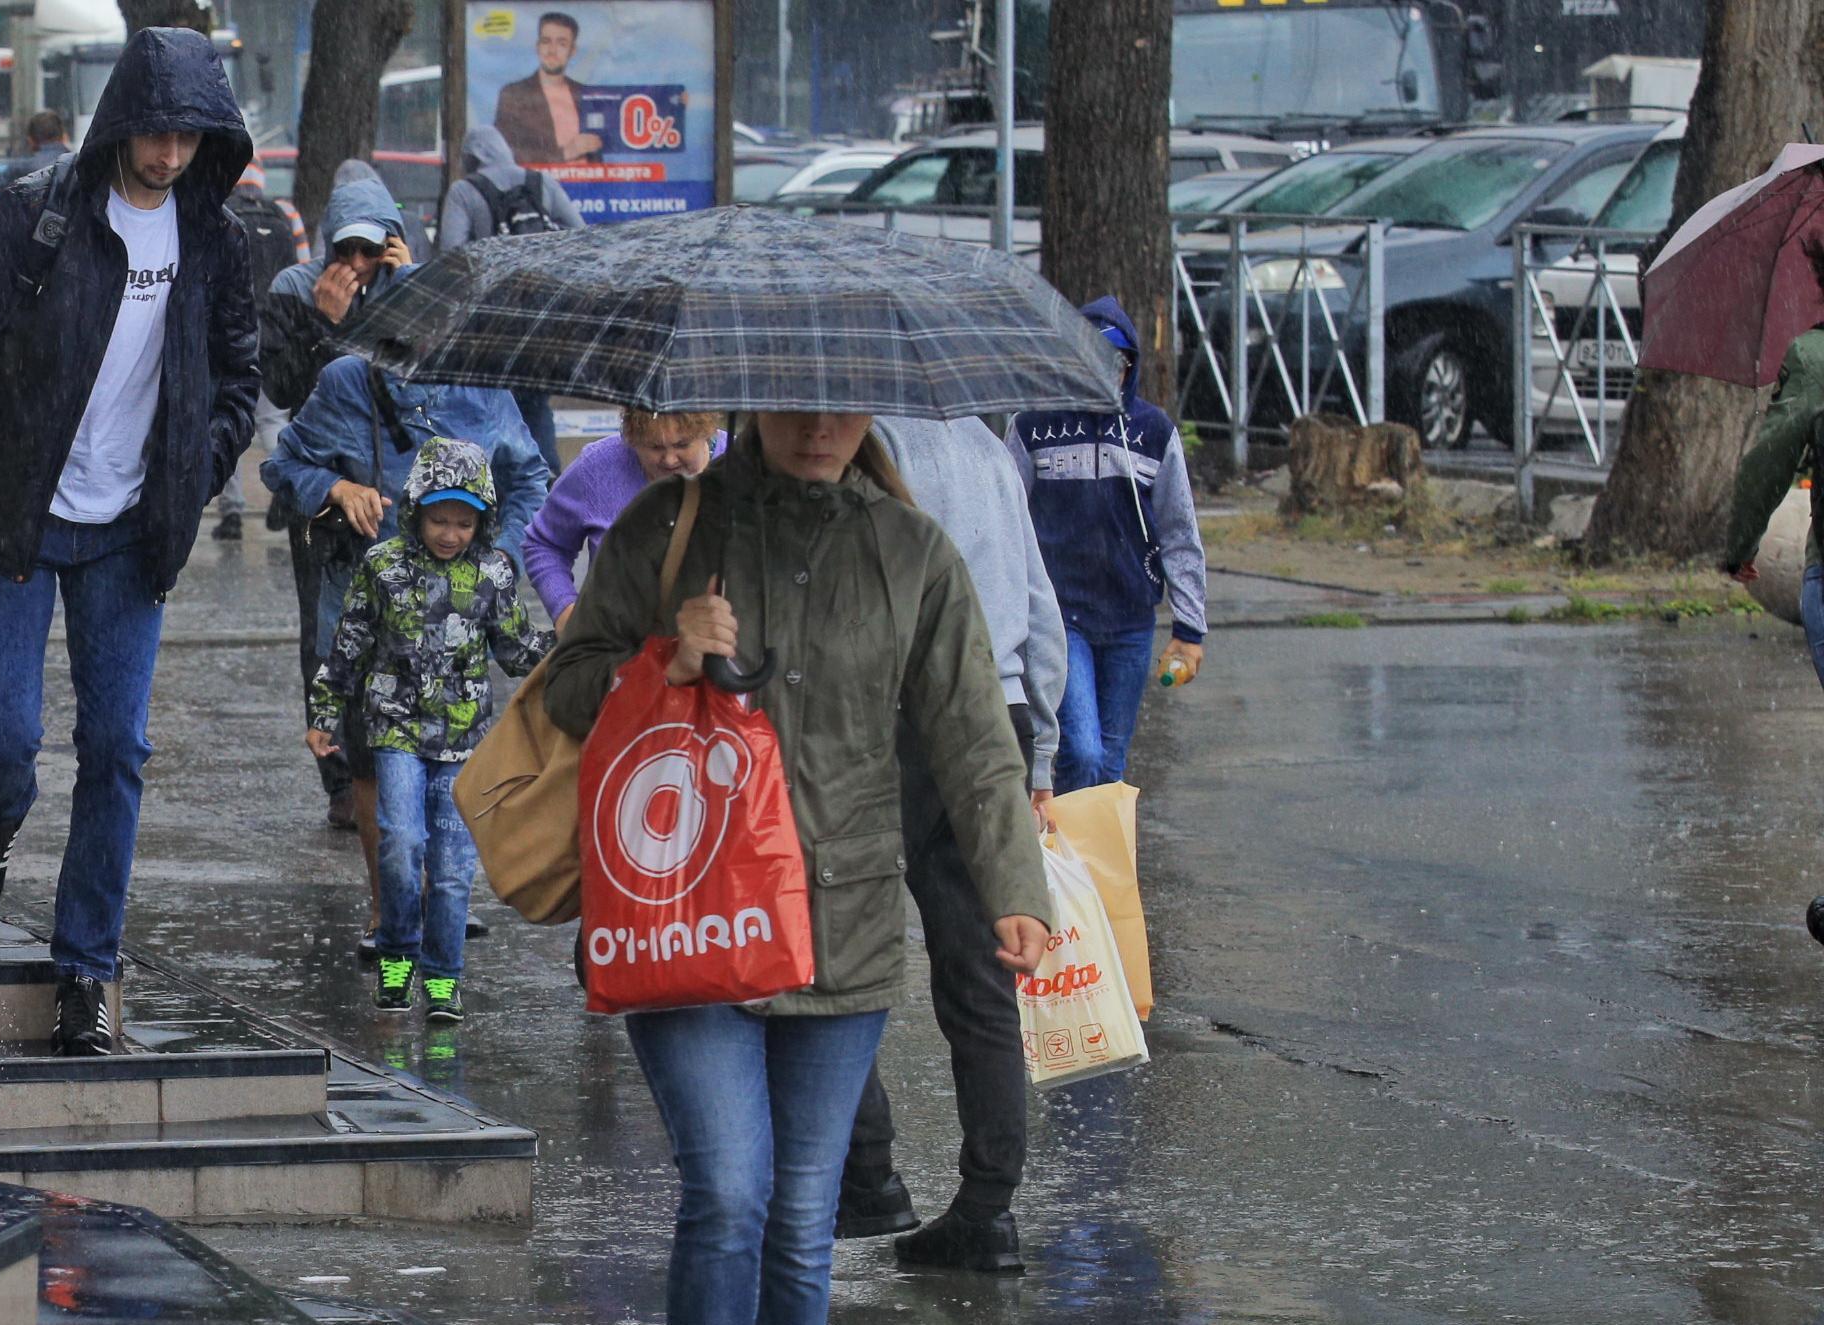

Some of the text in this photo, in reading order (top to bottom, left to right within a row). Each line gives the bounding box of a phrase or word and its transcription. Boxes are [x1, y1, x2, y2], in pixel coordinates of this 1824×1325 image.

[621, 94, 682, 150] 0%
[607, 166, 652, 182] карта
[573, 198, 687, 213] ело техники
[128, 262, 176, 290] ngel
